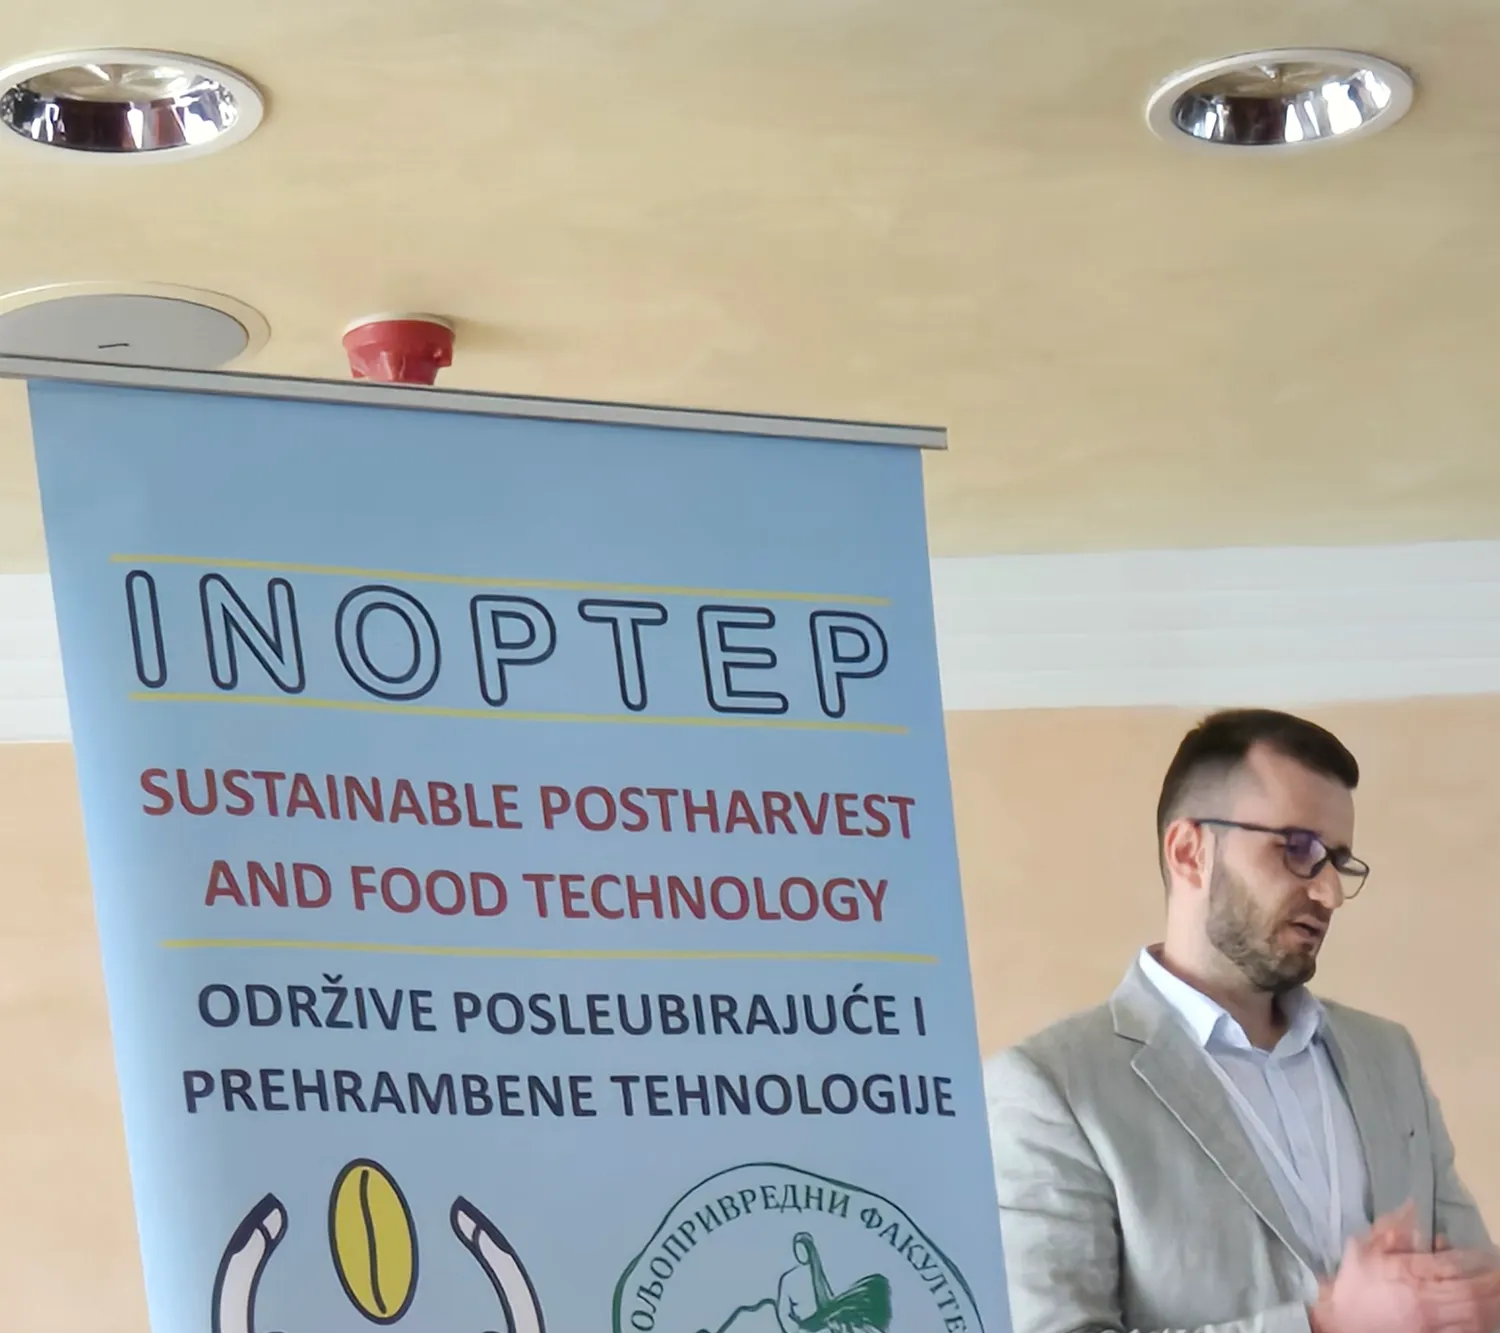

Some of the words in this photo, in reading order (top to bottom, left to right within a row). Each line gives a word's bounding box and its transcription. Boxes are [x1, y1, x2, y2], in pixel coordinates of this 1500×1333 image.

[125, 569, 890, 718] INOPTEP
[139, 767, 523, 831] SUSTAINABLE
[541, 784, 916, 840] POSTHARVEST
[204, 859, 332, 910] AND
[353, 865, 509, 918] FOOD
[523, 872, 890, 923] TECHNOLOGY
[197, 973, 433, 1034] ODRŽIVE
[454, 983, 901, 1037] POSLEUBIRAJUĆE
[915, 997, 926, 1037] I
[184, 1068, 597, 1117] PREHRAMBENE
[610, 1072, 957, 1118] TEHNOLOGIJE
